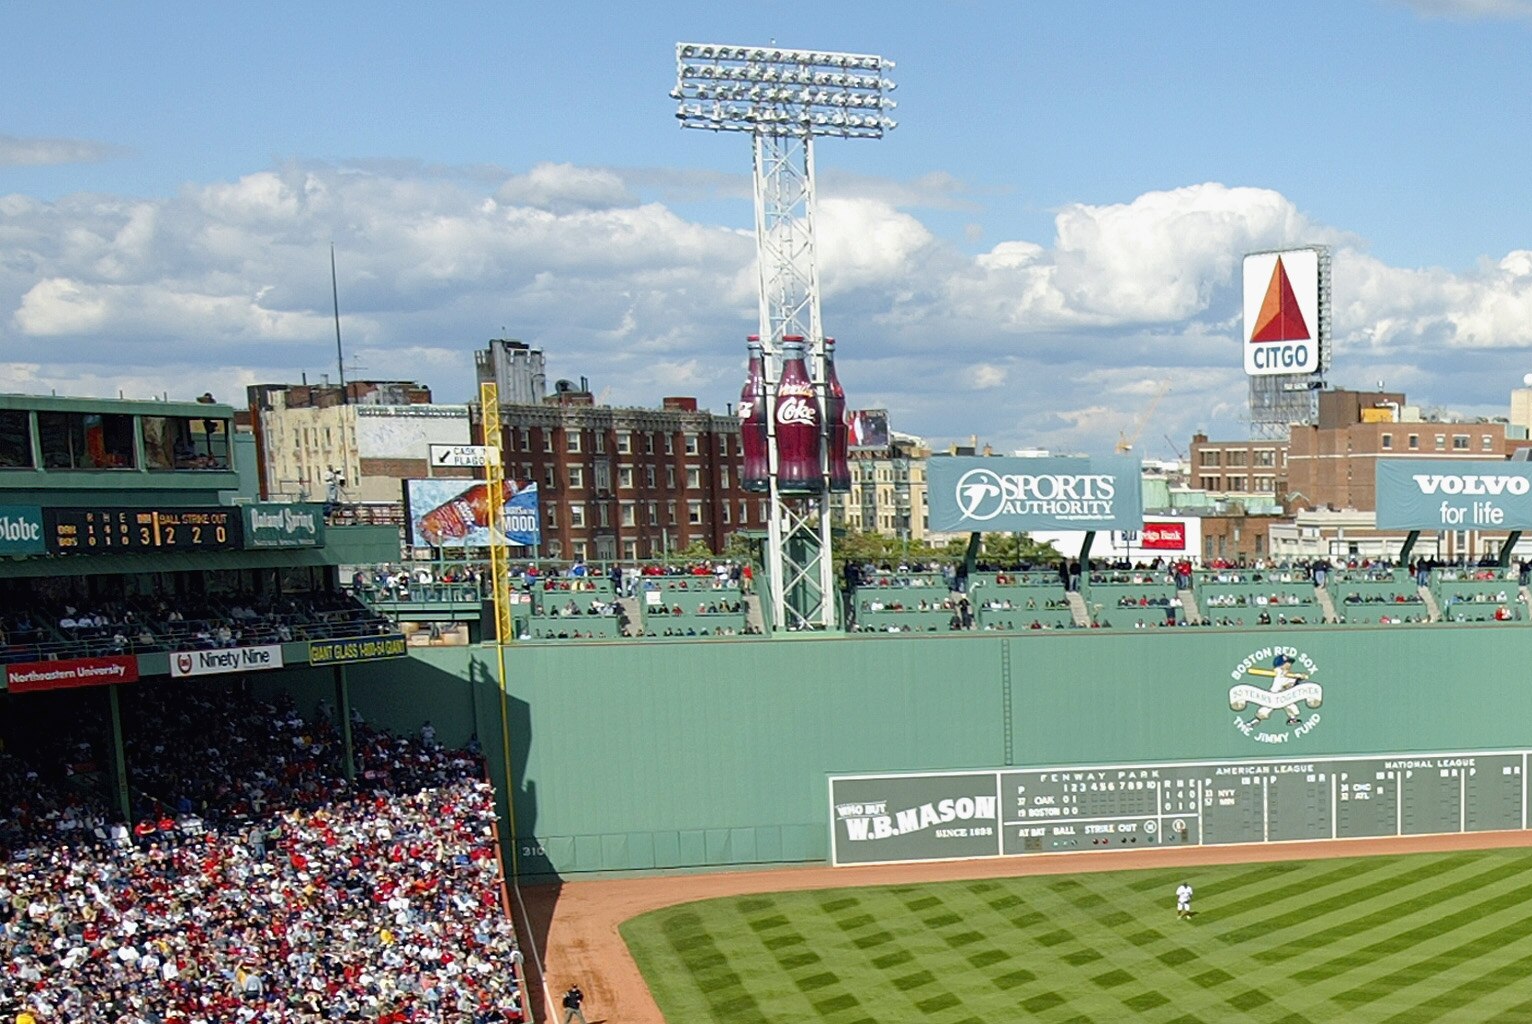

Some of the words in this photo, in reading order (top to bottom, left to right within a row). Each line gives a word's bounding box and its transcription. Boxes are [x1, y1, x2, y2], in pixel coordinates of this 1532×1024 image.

[1254, 345, 1308, 369] CITGO
[777, 397, 816, 426] Coke
[1002, 474, 1115, 500] SPORTS
[1412, 475, 1530, 495] VOLVO
[1002, 500, 1114, 514] AUTHORITY
[1439, 500, 1467, 524] for
[1473, 500, 1504, 524] life
[119, 512, 126, 523] E
[159, 514, 181, 525] BALL
[182, 514, 210, 525] STRIKE
[211, 513, 228, 524] OUT
[284, 508, 315, 534] Spring
[0, 516, 40, 541] lobe
[88, 525, 94, 534] 1
[121, 524, 128, 534] 0
[140, 527, 150, 545] 3
[165, 526, 176, 544] 2
[192, 526, 202, 544] 2
[216, 526, 226, 543] 0
[199, 650, 242, 669] Ninety
[242, 648, 270, 665] Nine
[1231, 647, 1272, 681] BOSTON
[1274, 646, 1297, 657] RED
[1298, 653, 1319, 675] SOX
[9, 670, 76, 684] Northeastern
[77, 664, 126, 677] University
[1233, 716, 1254, 736] THE
[1254, 732, 1289, 744] JIMMY
[1294, 713, 1321, 738] FUND
[1215, 766, 1270, 776] AMERICAN
[1274, 764, 1314, 773] LEAGUE
[1385, 759, 1433, 769] NATIONAL
[1437, 758, 1475, 767] LEAGUE
[1040, 772, 1106, 783] FENWAY
[1118, 770, 1160, 780] PARK
[1270, 775, 1277, 784] P
[1341, 773, 1348, 782] P
[1406, 770, 1413, 779] P
[1469, 768, 1476, 776] P
[1018, 786, 1025, 795] P
[1063, 784, 1068, 793] 1
[1071, 784, 1078, 792] 2
[1080, 783, 1086, 792] 3
[1091, 782, 1098, 791] 4
[1099, 782, 1106, 791] 5
[1108, 782, 1115, 791] 6
[1120, 781, 1126, 790] 7
[1128, 781, 1135, 790] 8
[1136, 781, 1143, 790] 9
[1146, 781, 1157, 790] 10
[1164, 780, 1171, 789] R
[1189, 779, 1195, 788] E
[1034, 796, 1055, 805] OAK
[1062, 795, 1069, 804] 0
[1072, 794, 1077, 803] 1
[1166, 790, 1170, 799] 1
[1177, 790, 1184, 799] 4
[1189, 790, 1196, 799] 0
[837, 805, 864, 817] WHO
[865, 803, 886, 815] BUT
[1028, 807, 1060, 817] BOSTON
[1063, 806, 1070, 816] 0
[1071, 805, 1078, 815] 0
[1165, 802, 1171, 811] 0
[1189, 801, 1196, 810] 0
[935, 828, 968, 838] SINCE
[1018, 829, 1030, 838] AT
[1031, 828, 1046, 837] BAT
[1053, 826, 1076, 836] BALL
[1118, 823, 1137, 833] OUT
